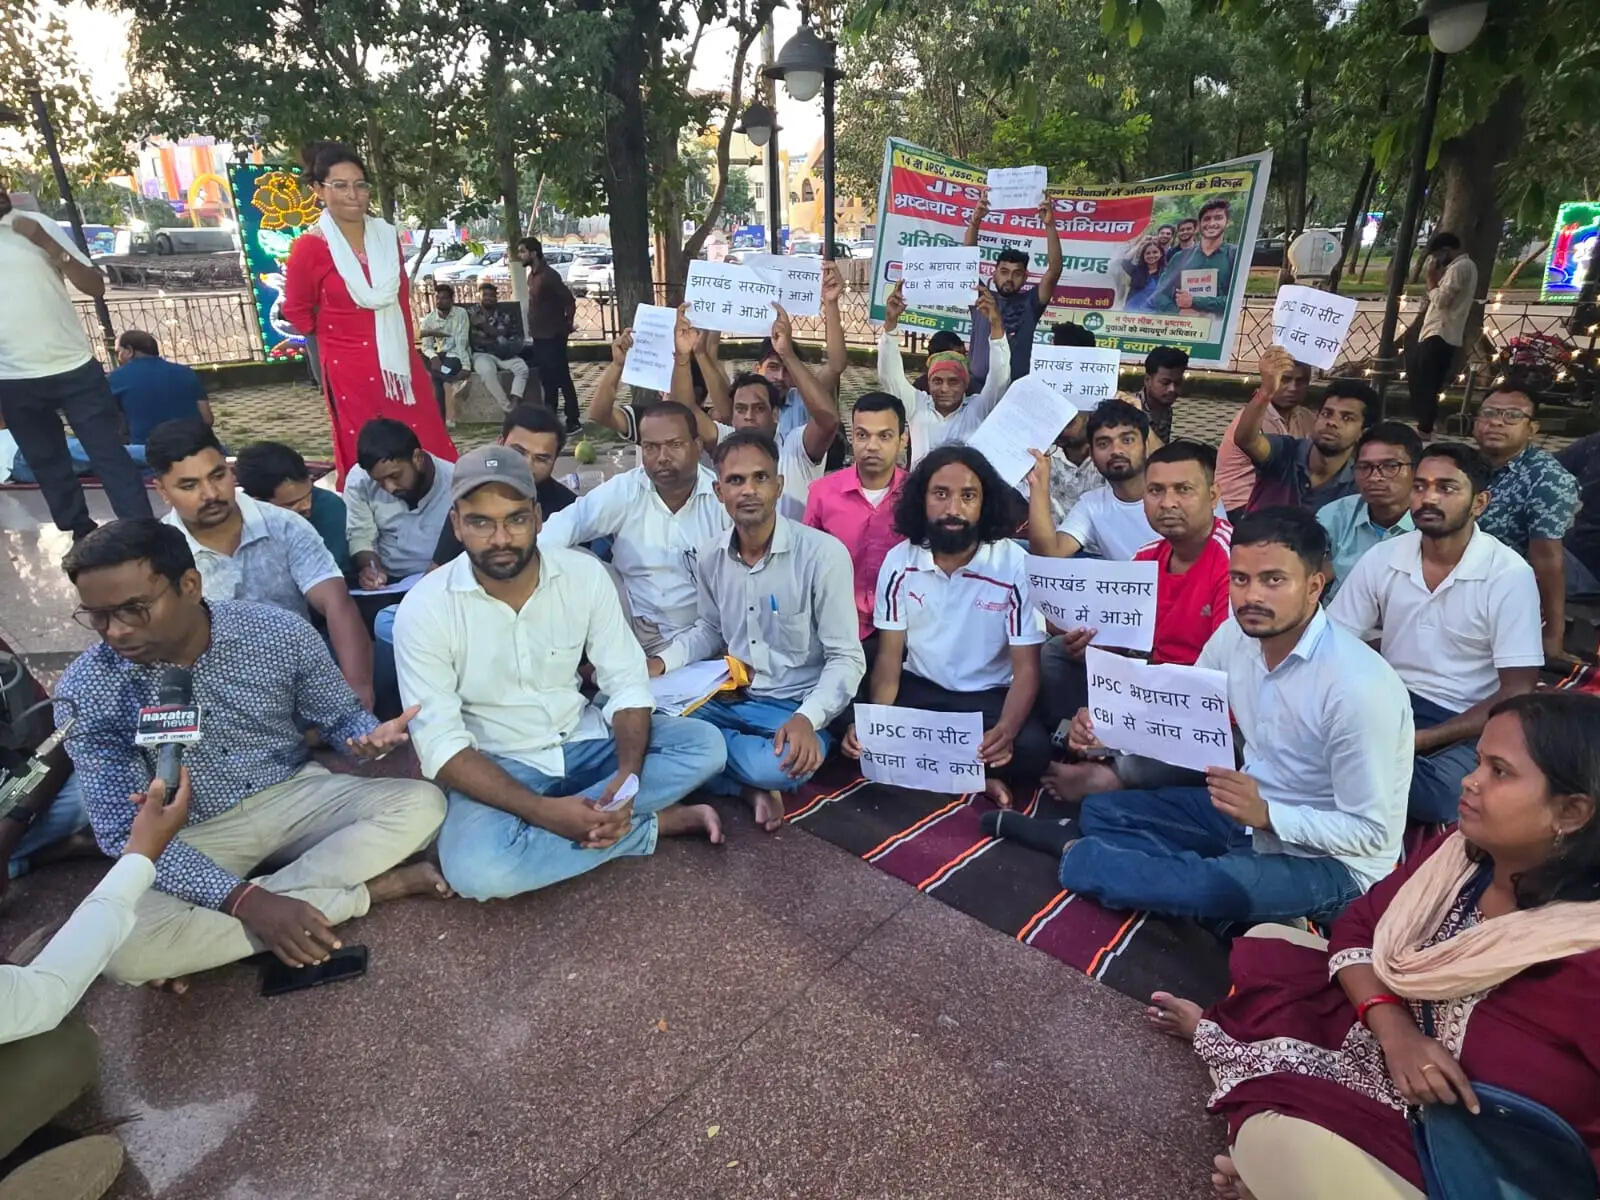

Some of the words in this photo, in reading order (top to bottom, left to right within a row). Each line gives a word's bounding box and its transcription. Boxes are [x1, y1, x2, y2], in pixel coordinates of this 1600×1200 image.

[926, 180, 981, 201] JPS
[894, 193, 959, 217] भ्रष्टाचार
[1055, 214, 1135, 234] अभियान
[1051, 199, 1097, 215] SC
[788, 269, 820, 283] सरकार
[905, 262, 924, 271] JPSC
[966, 260, 978, 271] को
[690, 275, 732, 290] झारखंड
[739, 281, 776, 298] सरकार
[923, 278, 932, 289] से
[789, 289, 814, 303] आओ
[693, 299, 715, 314] होश
[722, 300, 733, 315] में
[740, 305, 769, 320] आओ
[1300, 303, 1317, 317] का
[1318, 306, 1344, 325] सीट
[1290, 326, 1310, 345] बंद
[1315, 336, 1340, 353] करो
[1034, 356, 1073, 372] झारखंड
[1079, 362, 1116, 374] सरकार
[1062, 381, 1073, 394] में
[1079, 382, 1109, 397] आओ
[1029, 573, 1087, 593] झारखंड
[1096, 580, 1154, 597] सरकार
[1041, 600, 1066, 619] होश
[1075, 604, 1091, 623] में
[1100, 608, 1143, 627] आओ
[1091, 674, 1122, 695] JPSC
[1130, 684, 1191, 709] भ्रष्टाचार
[1201, 693, 1225, 713] को
[142, 710, 195, 722] naxatra
[163, 719, 195, 728] news
[869, 722, 906, 739] JPSC
[912, 726, 934, 742] का
[937, 726, 971, 746] सीट
[1093, 707, 1114, 726] CBI
[1122, 711, 1136, 731] से
[1145, 718, 1183, 740] जांच
[1193, 727, 1228, 748] करो
[862, 748, 906, 769] बेचना
[915, 752, 939, 774] बंद
[949, 759, 982, 776] करो
